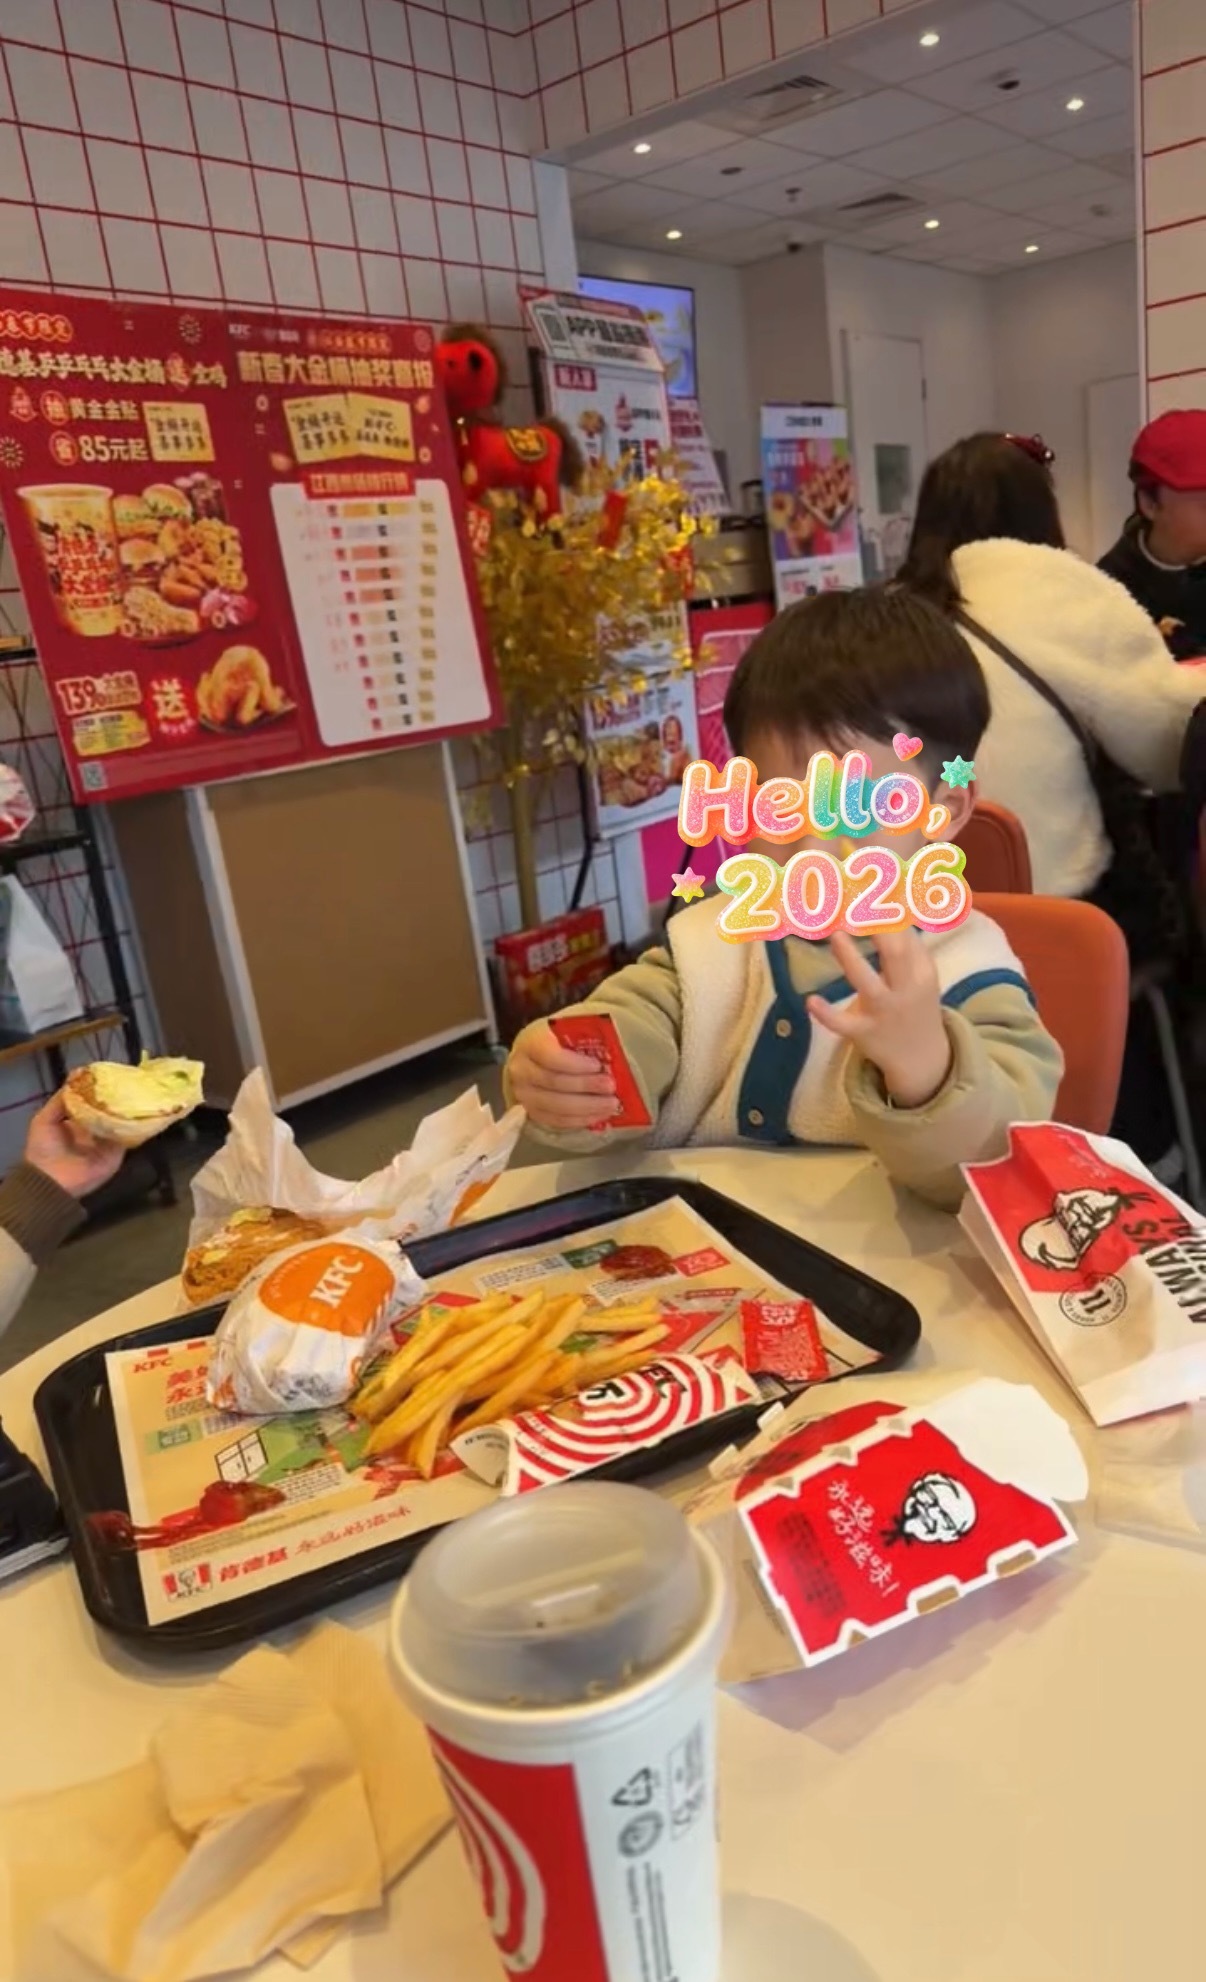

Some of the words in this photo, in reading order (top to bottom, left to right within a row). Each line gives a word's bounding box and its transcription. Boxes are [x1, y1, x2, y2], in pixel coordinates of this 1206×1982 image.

[78, 435, 149, 462] 85元起
[308, 1256, 364, 1309] KFC
[133, 1357, 172, 1374] KFC
[219, 1547, 288, 1582] 肯德基
[295, 1506, 411, 1555] 永远好滋味
